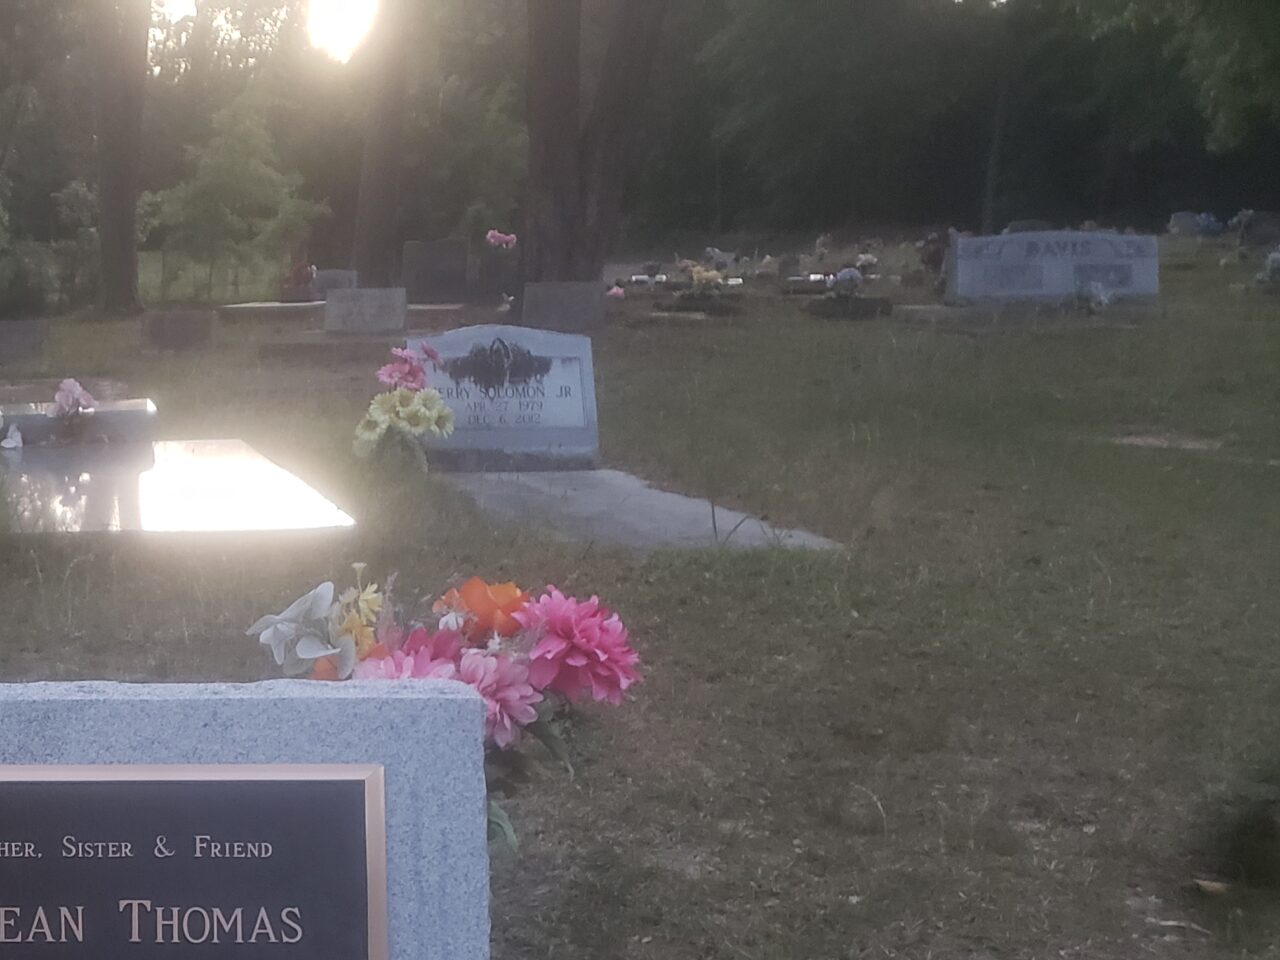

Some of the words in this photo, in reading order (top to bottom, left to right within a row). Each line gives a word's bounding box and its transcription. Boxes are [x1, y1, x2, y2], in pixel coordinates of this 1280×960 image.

[434, 386, 471, 399] ERRY
[154, 835, 176, 859] &
[118, 898, 303, 944] THOMAS
